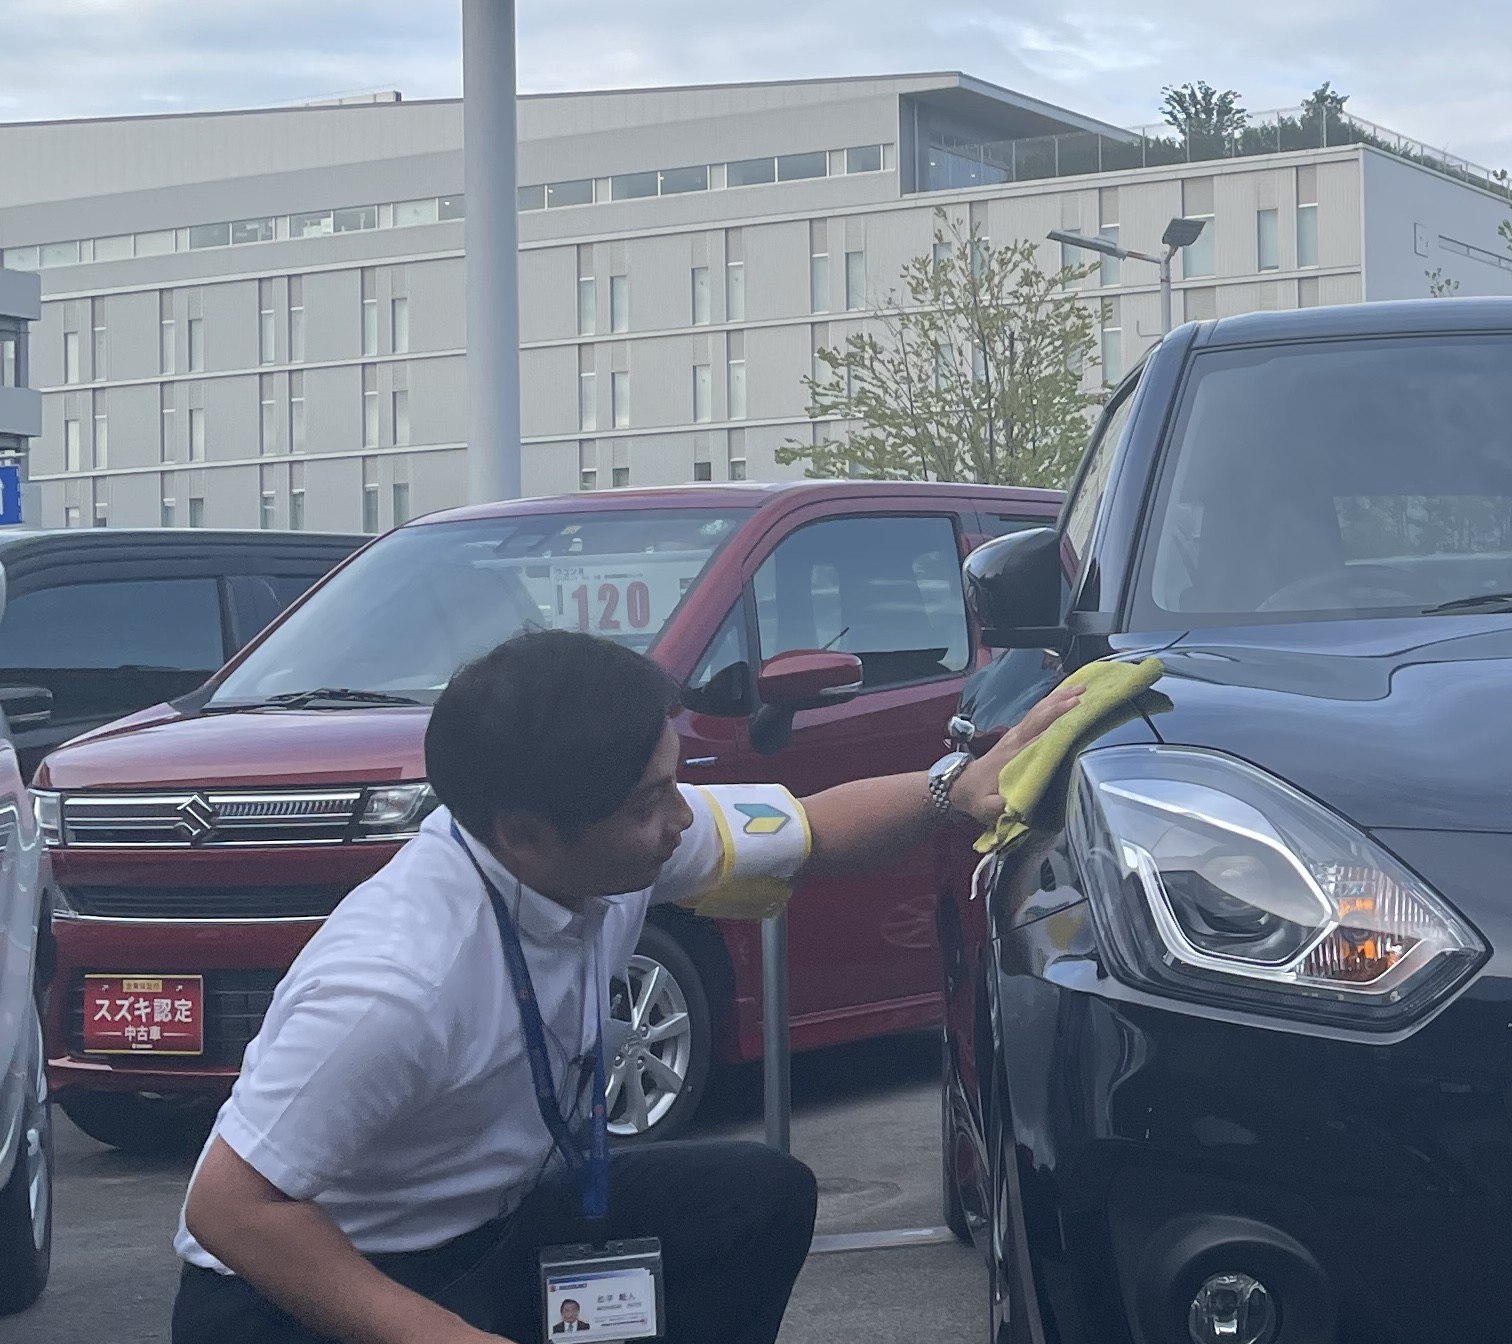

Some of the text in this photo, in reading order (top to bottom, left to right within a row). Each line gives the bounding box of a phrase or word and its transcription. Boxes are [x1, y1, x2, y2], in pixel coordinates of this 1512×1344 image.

[571, 581, 650, 632] 120
[93, 996, 193, 1023] スズキ認定
